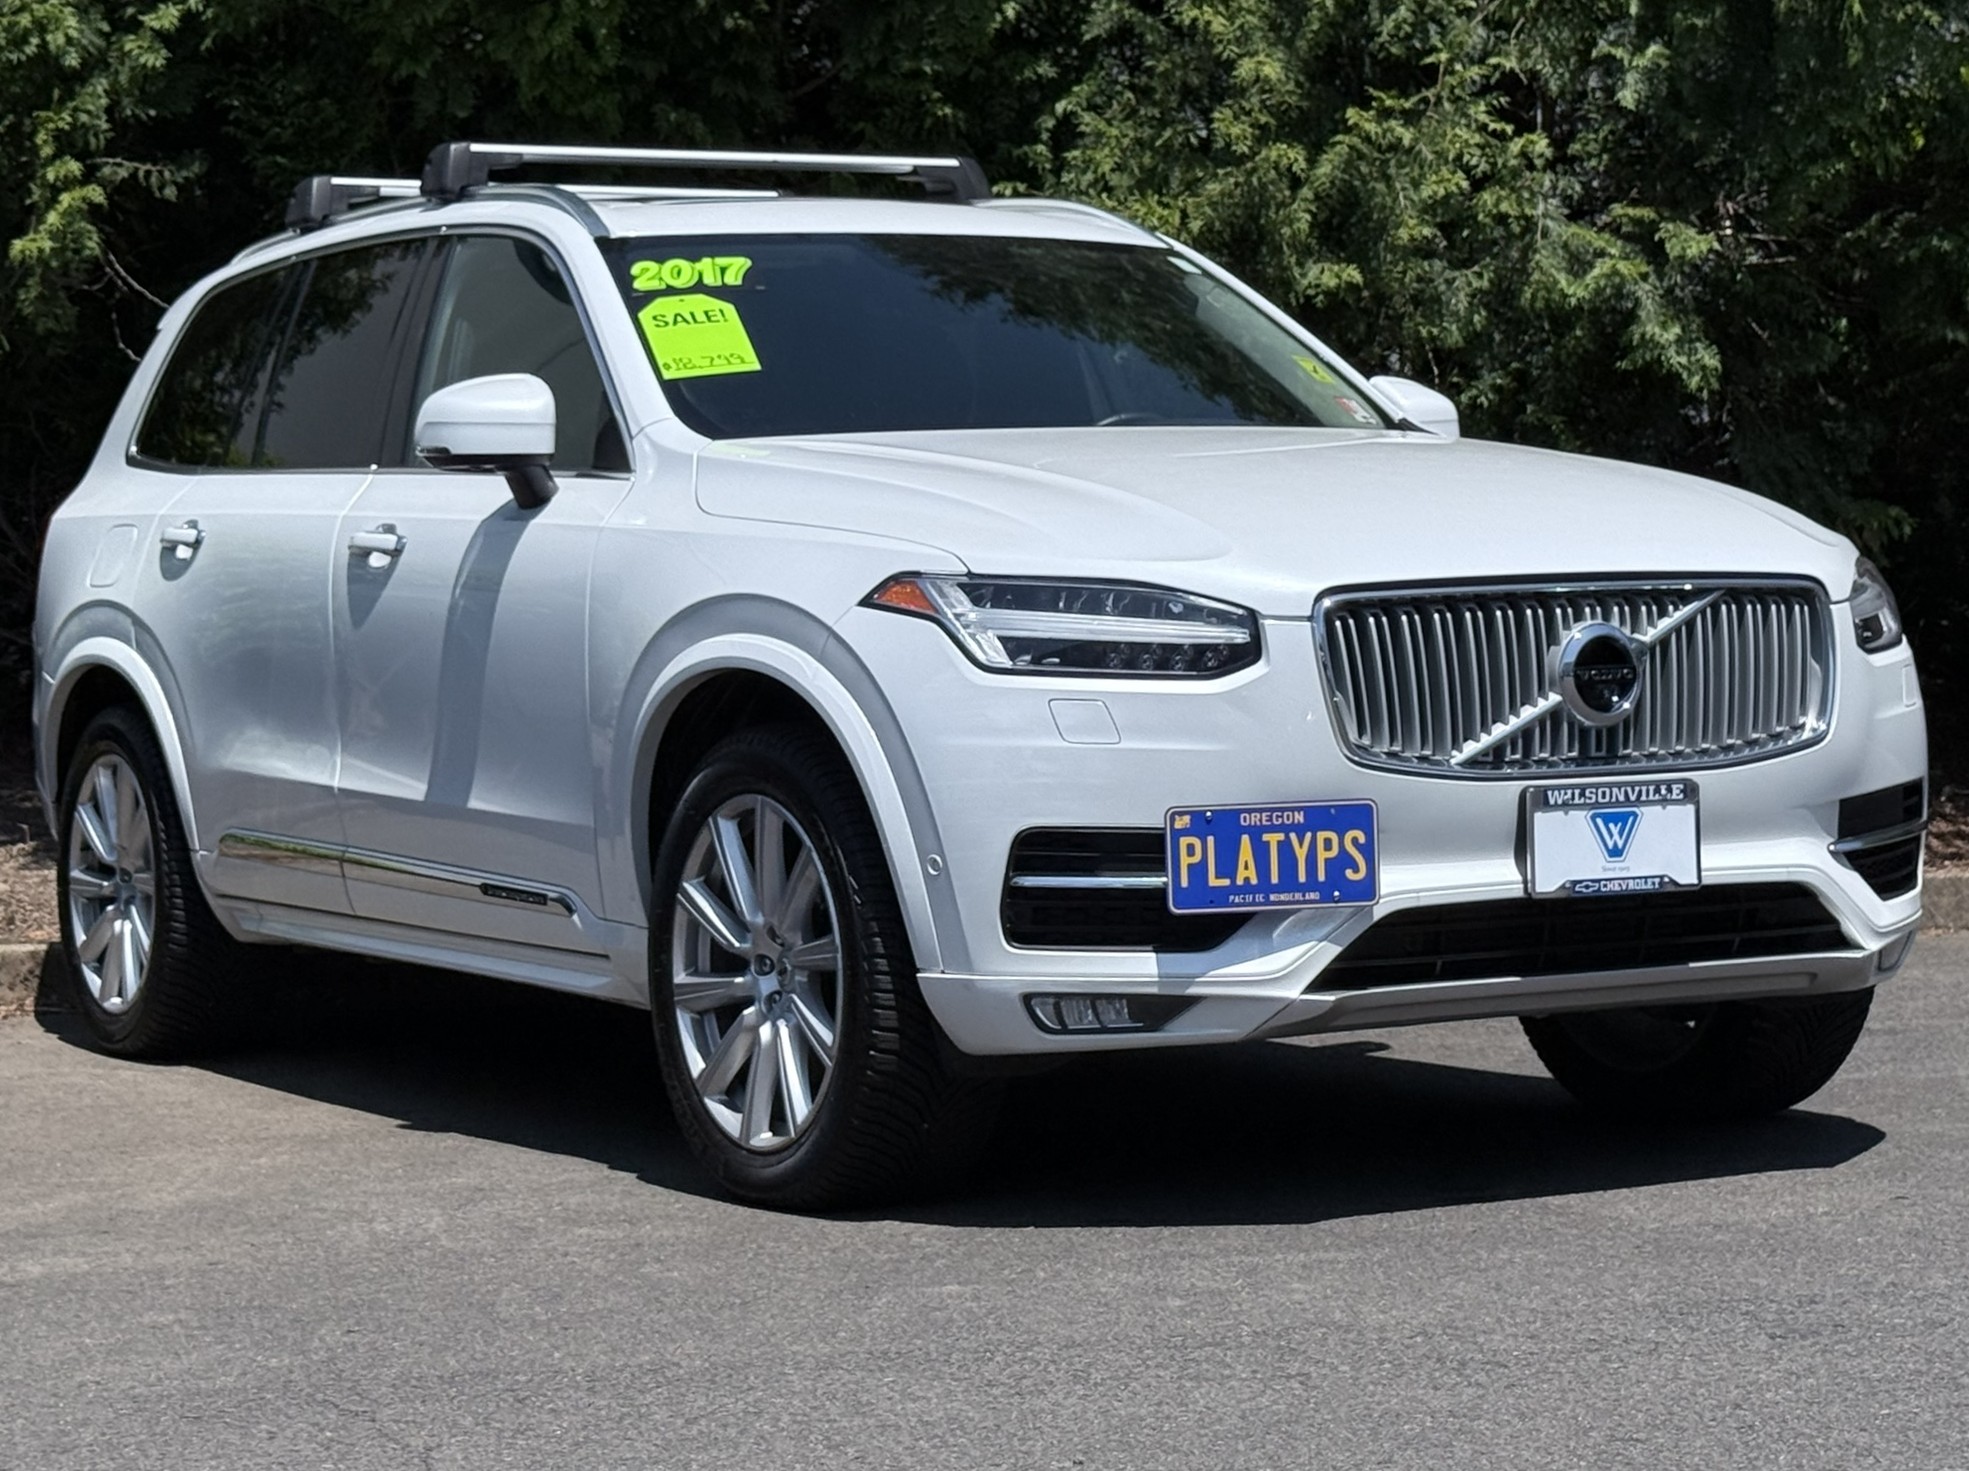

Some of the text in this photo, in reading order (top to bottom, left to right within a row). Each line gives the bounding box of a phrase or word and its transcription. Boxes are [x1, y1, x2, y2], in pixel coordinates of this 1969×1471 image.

[630, 256, 752, 291] 2017
[652, 309, 729, 328] SALE!
[1240, 811, 1305, 827] OREGON
[1179, 829, 1367, 888] PLATYPS
[1600, 877, 1661, 892] CHEVROLET
[1228, 891, 1321, 904] PACIFIC WONDERLAND
